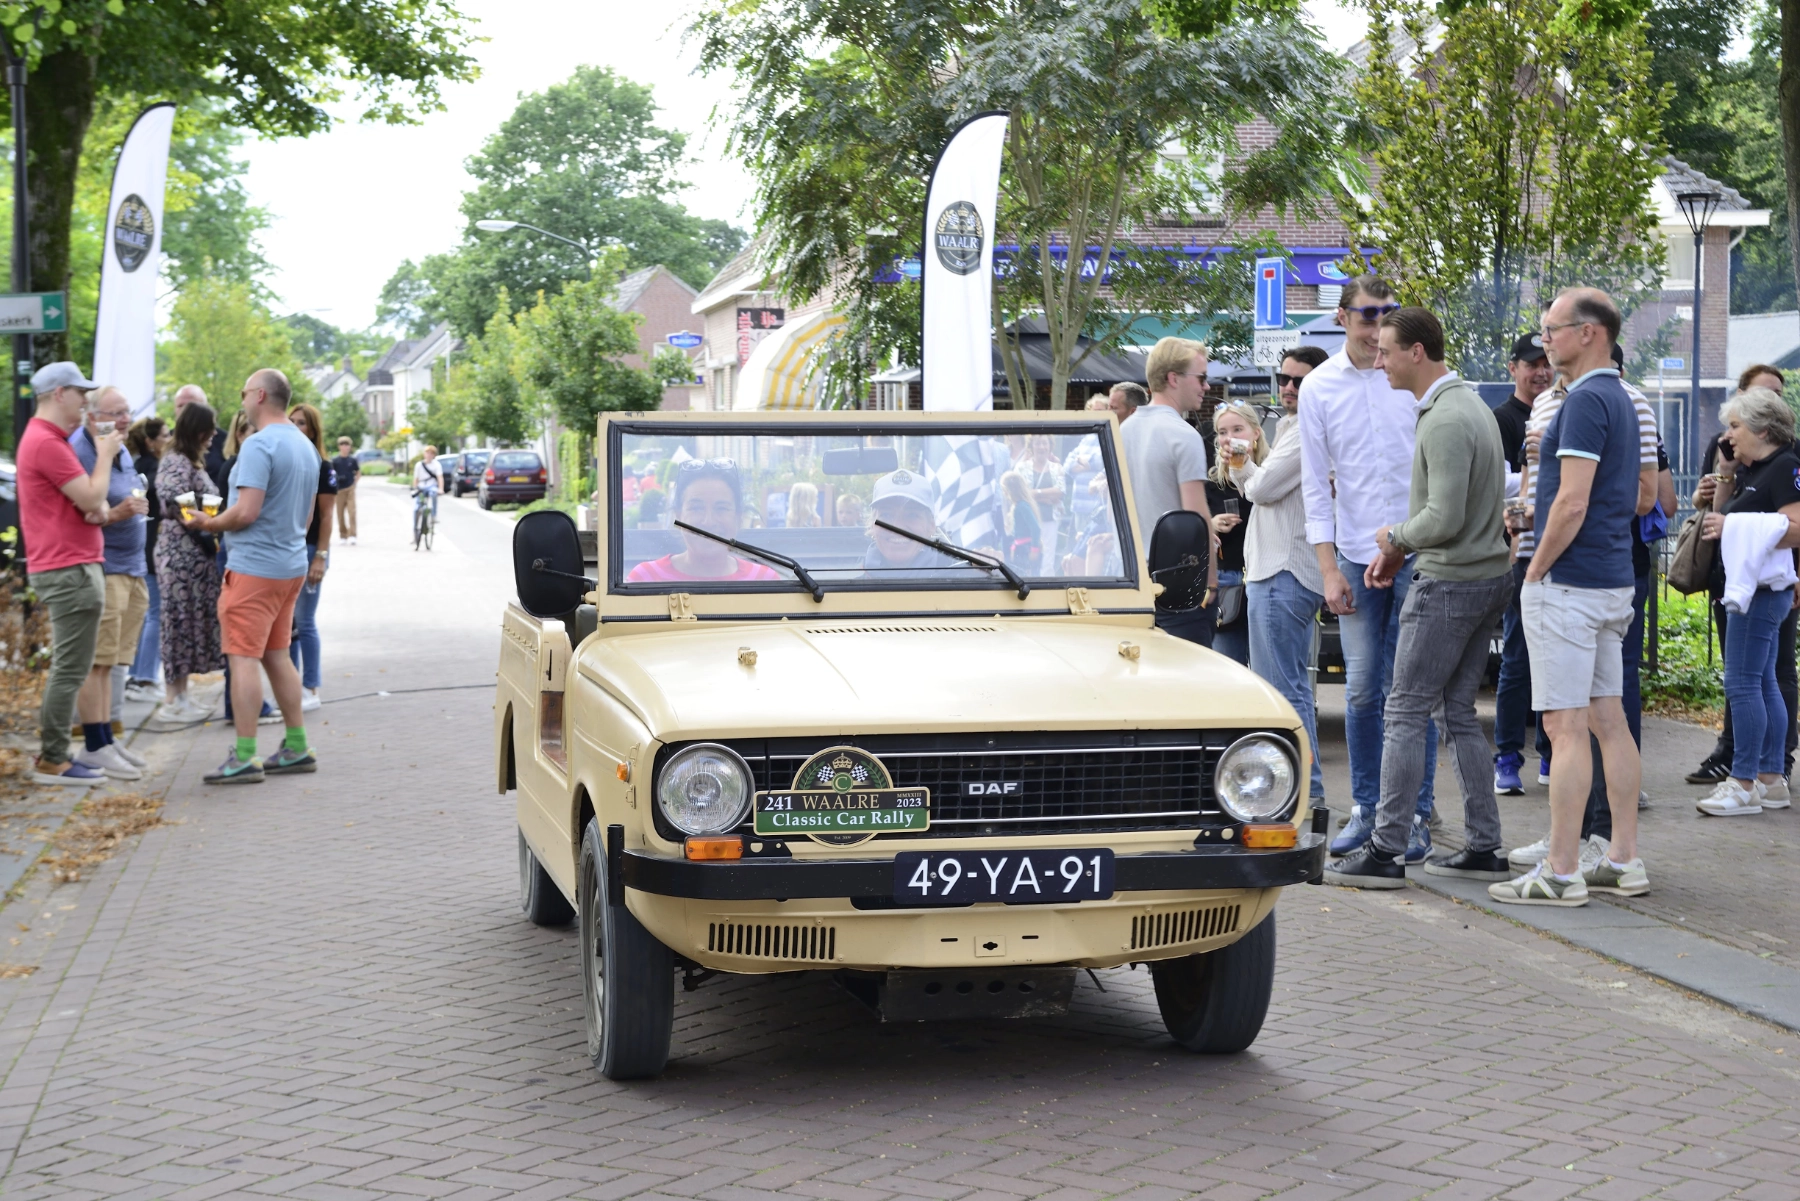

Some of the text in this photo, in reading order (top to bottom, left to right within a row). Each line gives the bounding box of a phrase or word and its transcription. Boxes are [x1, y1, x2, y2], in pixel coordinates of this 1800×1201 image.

[938, 235, 980, 249] WAALR
[968, 783, 1018, 795] DAF
[764, 794, 880, 811] 241 WAALRE
[896, 798, 922, 808] 2023
[772, 811, 915, 827] Classic Car Rally
[908, 855, 1101, 896] 49-YA-91
